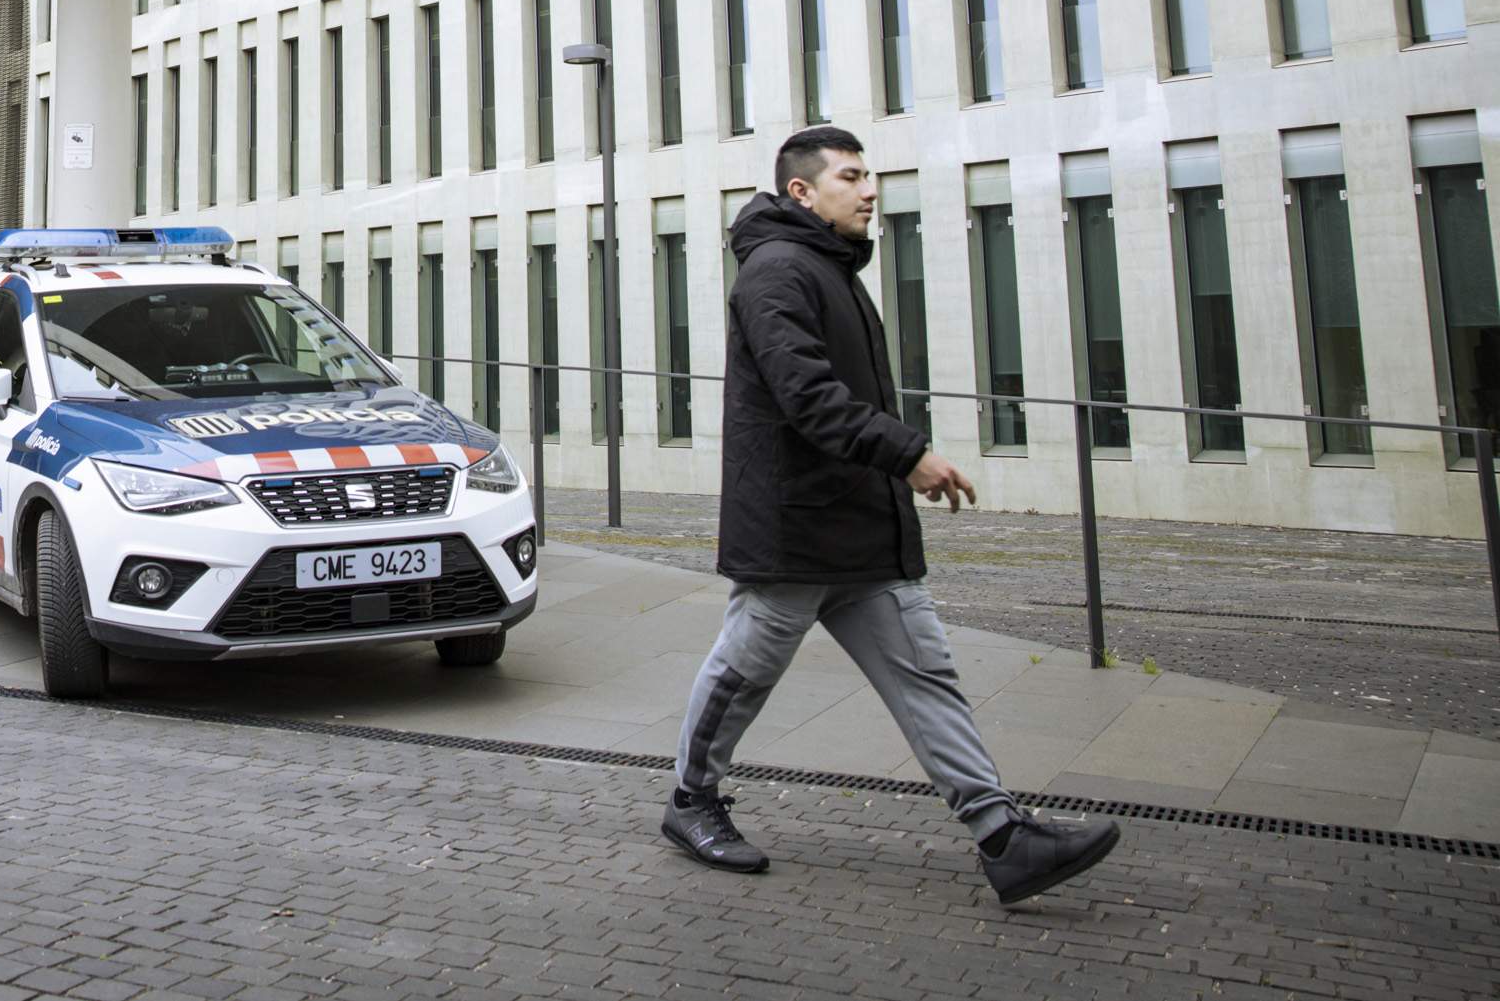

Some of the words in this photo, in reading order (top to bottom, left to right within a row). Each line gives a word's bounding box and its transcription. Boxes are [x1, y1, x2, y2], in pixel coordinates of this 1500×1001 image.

[241, 408, 420, 430] policia
[313, 554, 356, 581] CME
[371, 549, 426, 577] 9423
